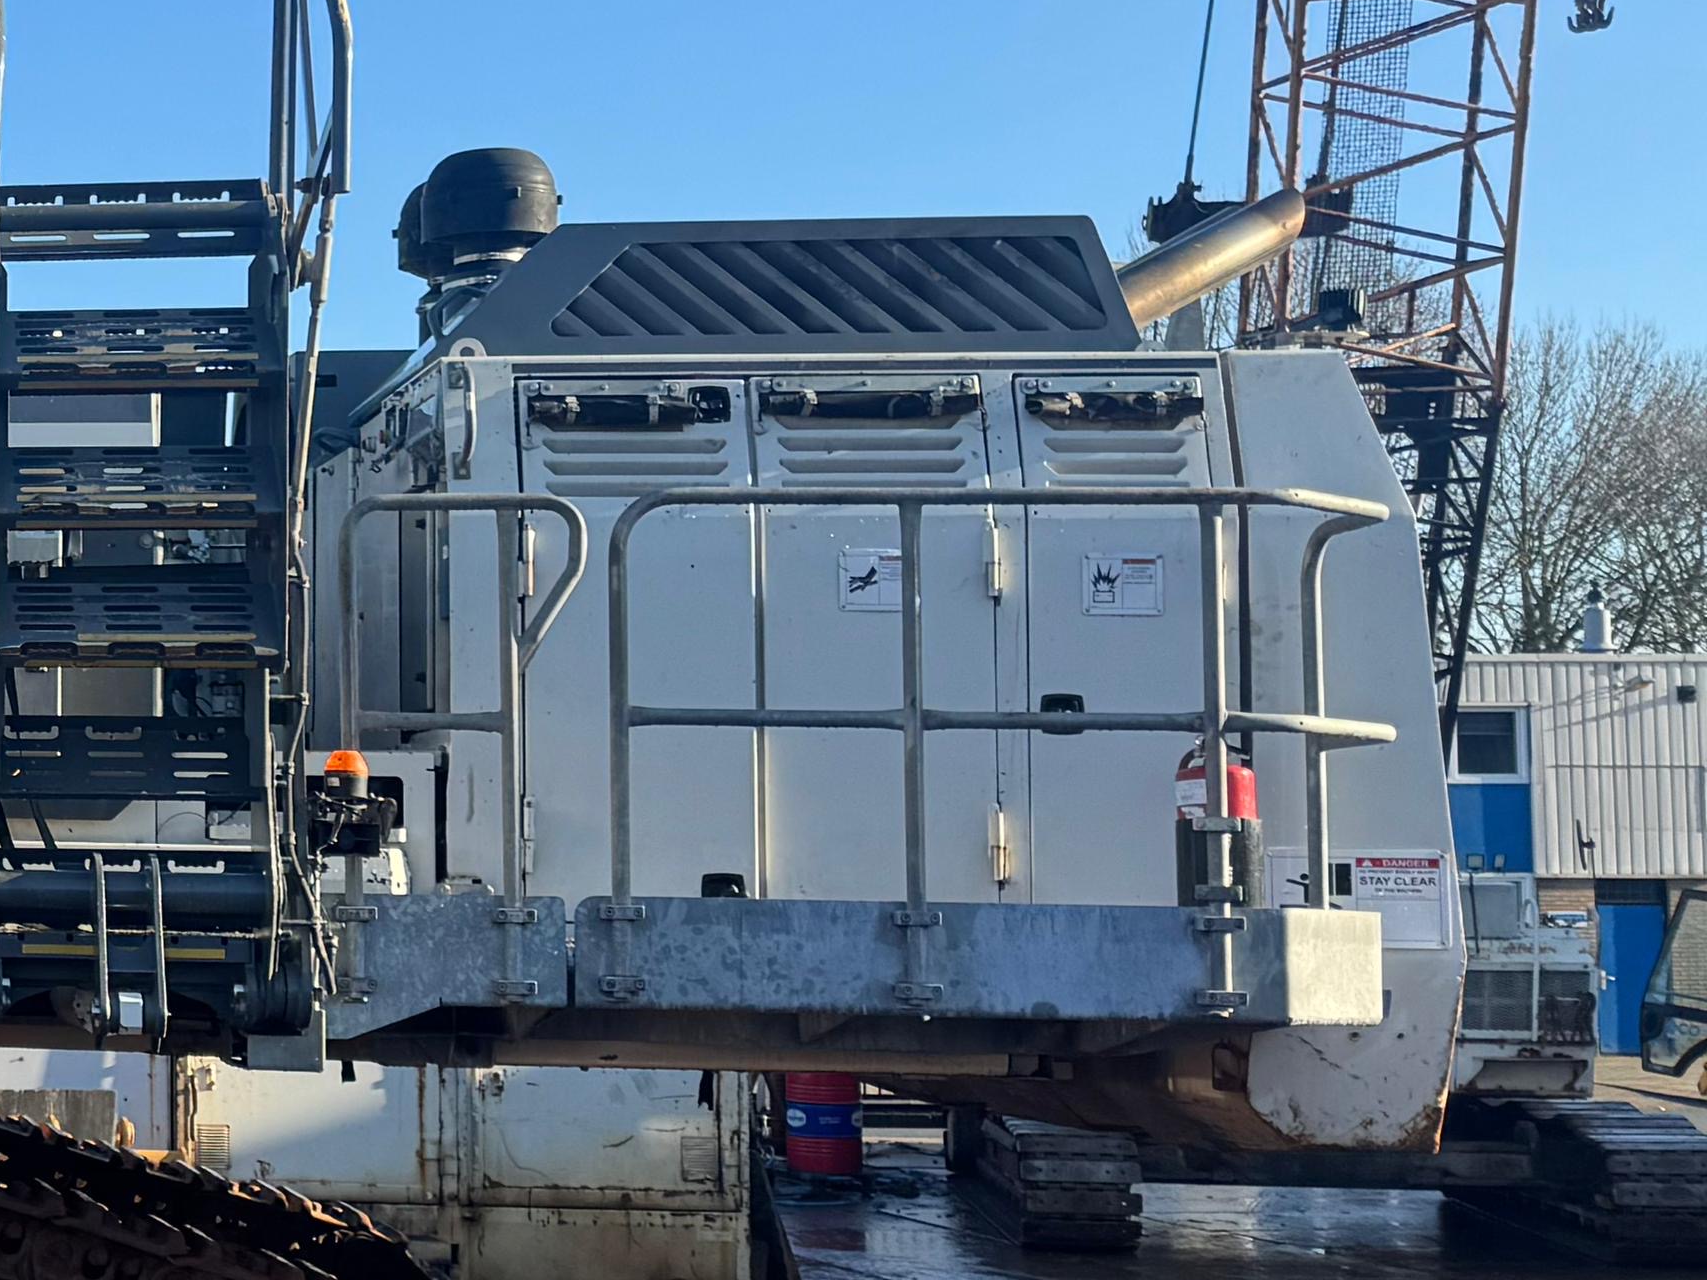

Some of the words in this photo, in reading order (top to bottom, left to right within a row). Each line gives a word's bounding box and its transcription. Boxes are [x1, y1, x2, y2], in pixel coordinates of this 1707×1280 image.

[1382, 859, 1429, 868] DANGER
[1359, 876, 1391, 886] STAY
[1394, 876, 1437, 887] CLEAR
